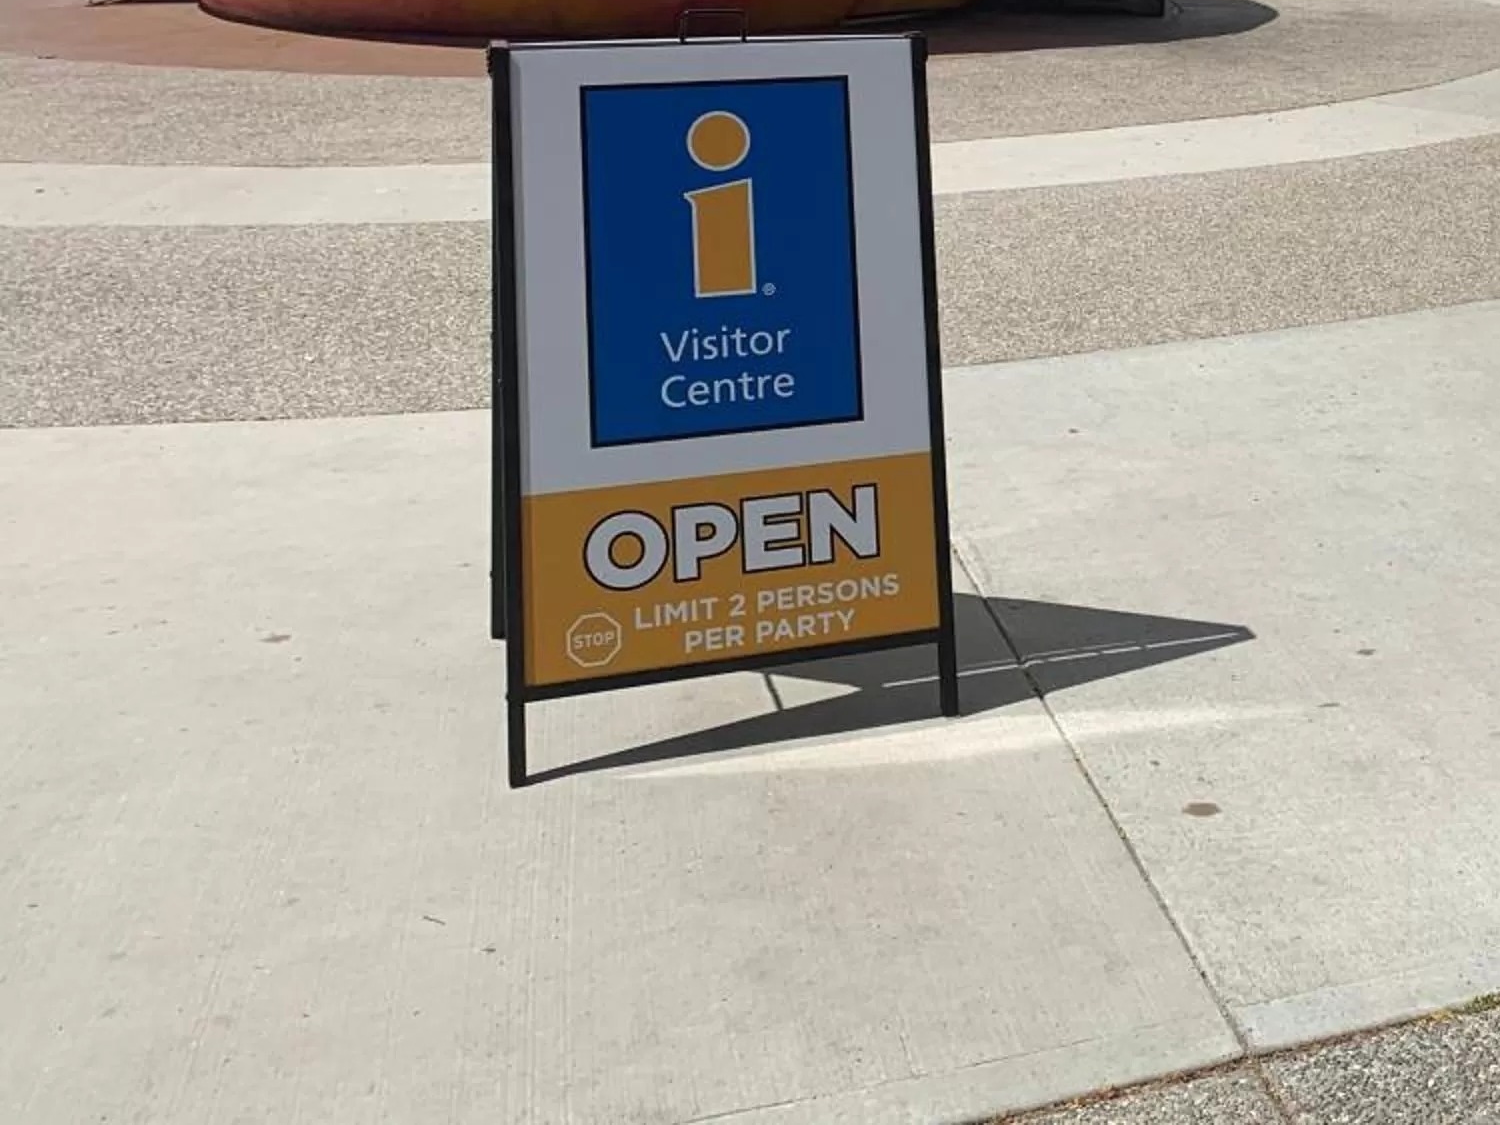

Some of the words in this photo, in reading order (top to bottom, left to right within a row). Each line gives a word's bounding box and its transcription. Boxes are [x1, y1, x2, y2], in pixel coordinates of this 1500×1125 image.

[660, 324, 791, 363] Visitor
[661, 372, 795, 408] Centre
[583, 483, 880, 591] OPEN
[635, 596, 718, 630] LIMIT
[729, 594, 747, 618] 2
[757, 574, 900, 613] PERSONS
[572, 630, 615, 650] STOP
[685, 625, 744, 654] PER
[756, 608, 855, 643] PARTY
